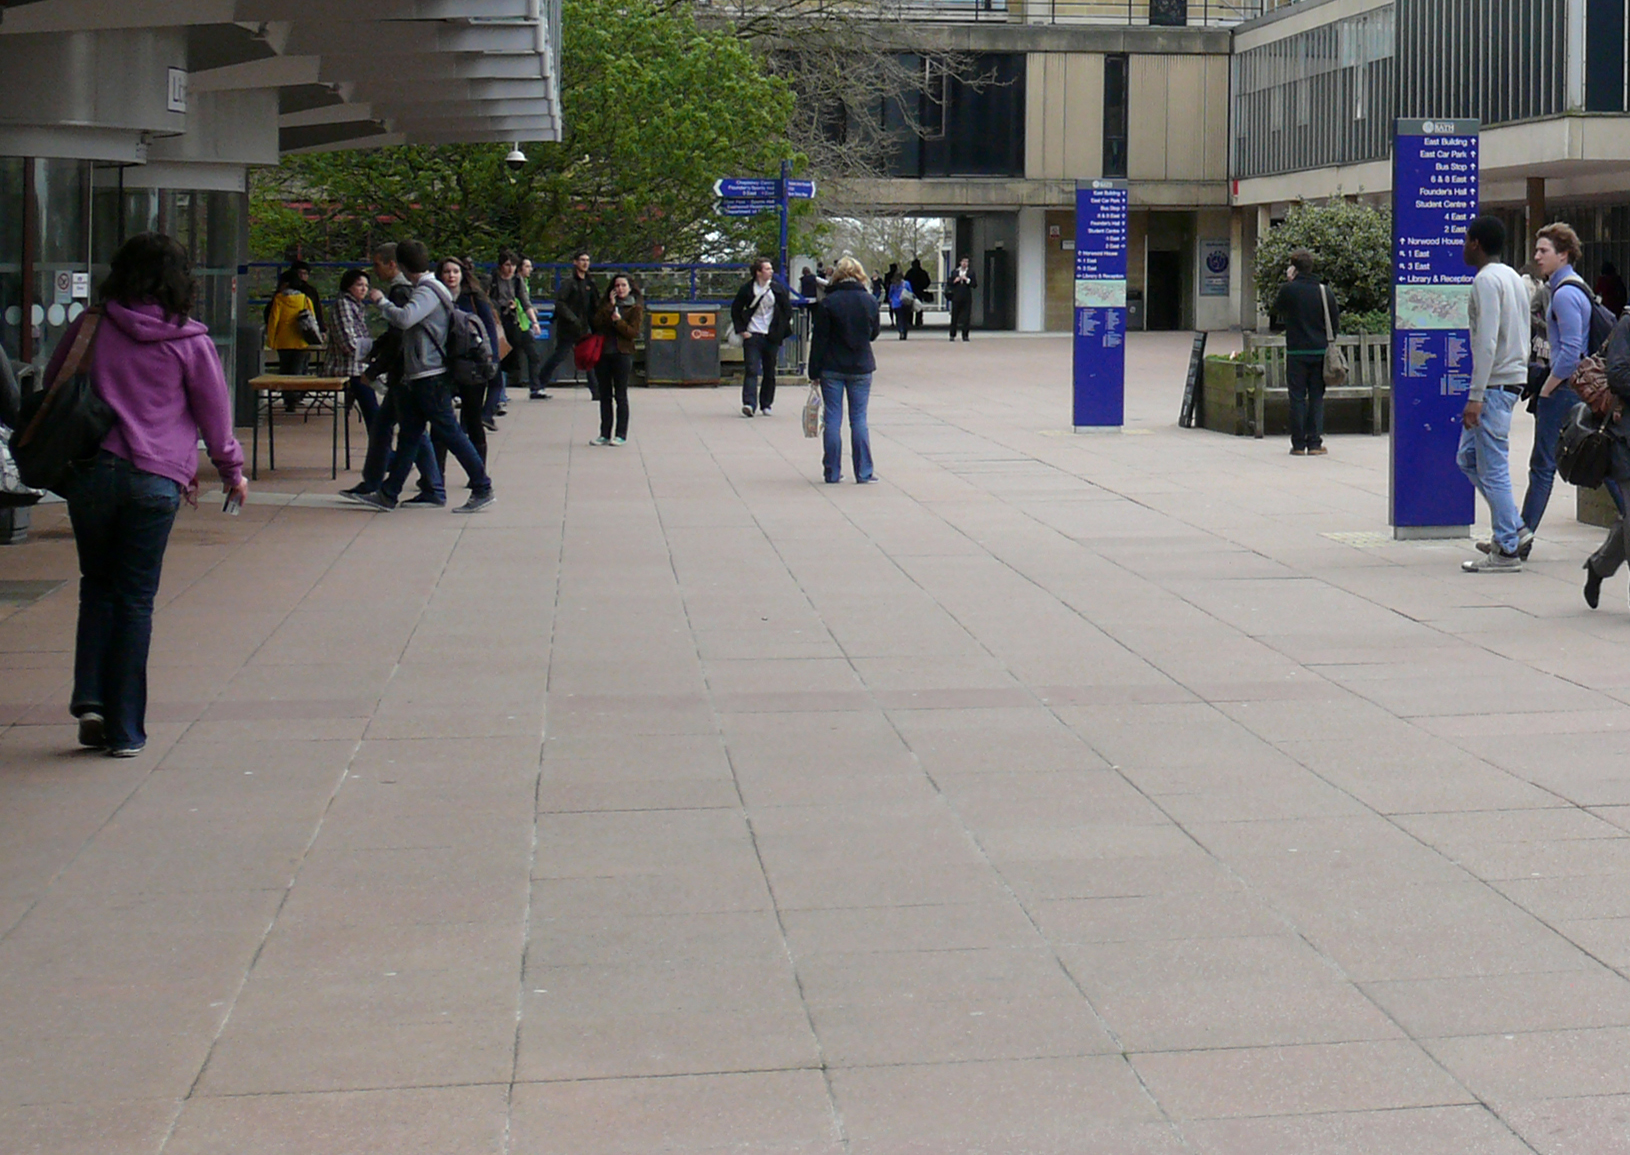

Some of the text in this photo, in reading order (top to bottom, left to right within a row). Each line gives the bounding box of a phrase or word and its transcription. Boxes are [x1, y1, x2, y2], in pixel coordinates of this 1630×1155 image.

[1423, 137, 1468, 148] East Building
[1419, 149, 1467, 158] East Car Park
[1435, 162, 1468, 172] Bus Stop
[1430, 175, 1436, 183] 6
[1437, 175, 1444, 183] &
[1451, 175, 1467, 183] East
[1419, 187, 1468, 196] Founder's Hall
[1415, 199, 1467, 208] Student Centre
[1443, 212, 1467, 221] 4 East
[1443, 225, 1467, 233] 2 East
[1407, 237, 1464, 246] Norwood House
[1413, 249, 1430, 258] East
[1407, 262, 1431, 271] 3 East
[1406, 275, 1475, 284] Library & Reception
